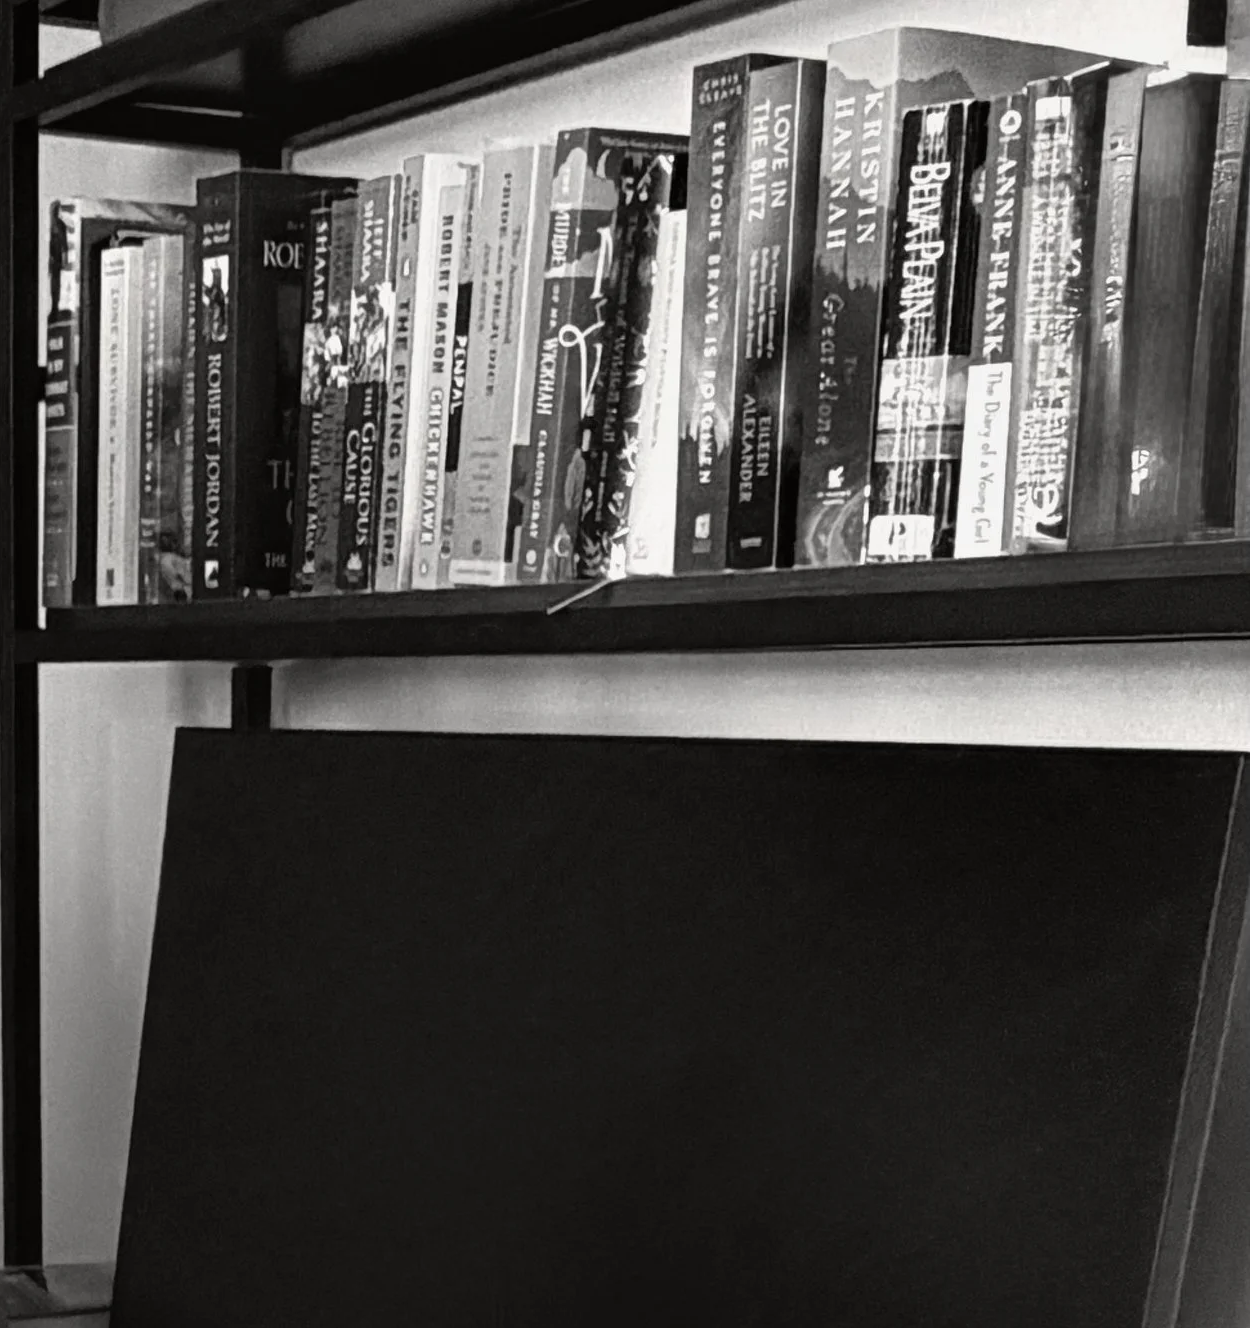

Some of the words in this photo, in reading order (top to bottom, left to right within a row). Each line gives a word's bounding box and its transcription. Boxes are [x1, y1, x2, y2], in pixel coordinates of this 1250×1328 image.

[751, 98, 771, 152] THE
[773, 103, 792, 172] LOVE
[708, 121, 727, 242] EVERYONE
[748, 157, 767, 223] BLITZ
[770, 180, 787, 208] IN
[826, 97, 855, 250] HANNAH
[856, 91, 885, 244] KRISTIN
[991, 159, 1017, 241] ANNE
[311, 220, 328, 320] SHAARA
[360, 200, 375, 283] SHAARA
[438, 215, 454, 292] ROBERT
[395, 298, 410, 350] THE
[704, 254, 722, 325] BRAVE
[981, 251, 1010, 358] FRANK
[432, 302, 449, 374] MASON
[449, 335, 467, 415] PENPAL
[703, 337, 717, 358] IS
[206, 353, 222, 447] ROBERT
[389, 364, 407, 460] FLYING
[978, 401, 1001, 438] Diary
[986, 370, 1003, 397] The
[699, 370, 717, 484] FORGIVEN
[739, 393, 757, 503] ALEXANDER
[756, 415, 772, 477] EILEEN
[979, 443, 998, 458] of
[980, 461, 990, 469] a
[205, 454, 220, 548] JORDAN
[344, 429, 360, 504] CAUSE
[355, 422, 376, 546] GLORIOUS
[420, 388, 443, 544] CHICKENHAWK
[971, 471, 995, 514] Young
[381, 472, 399, 567] TIGERS
[974, 518, 991, 544] Girl
